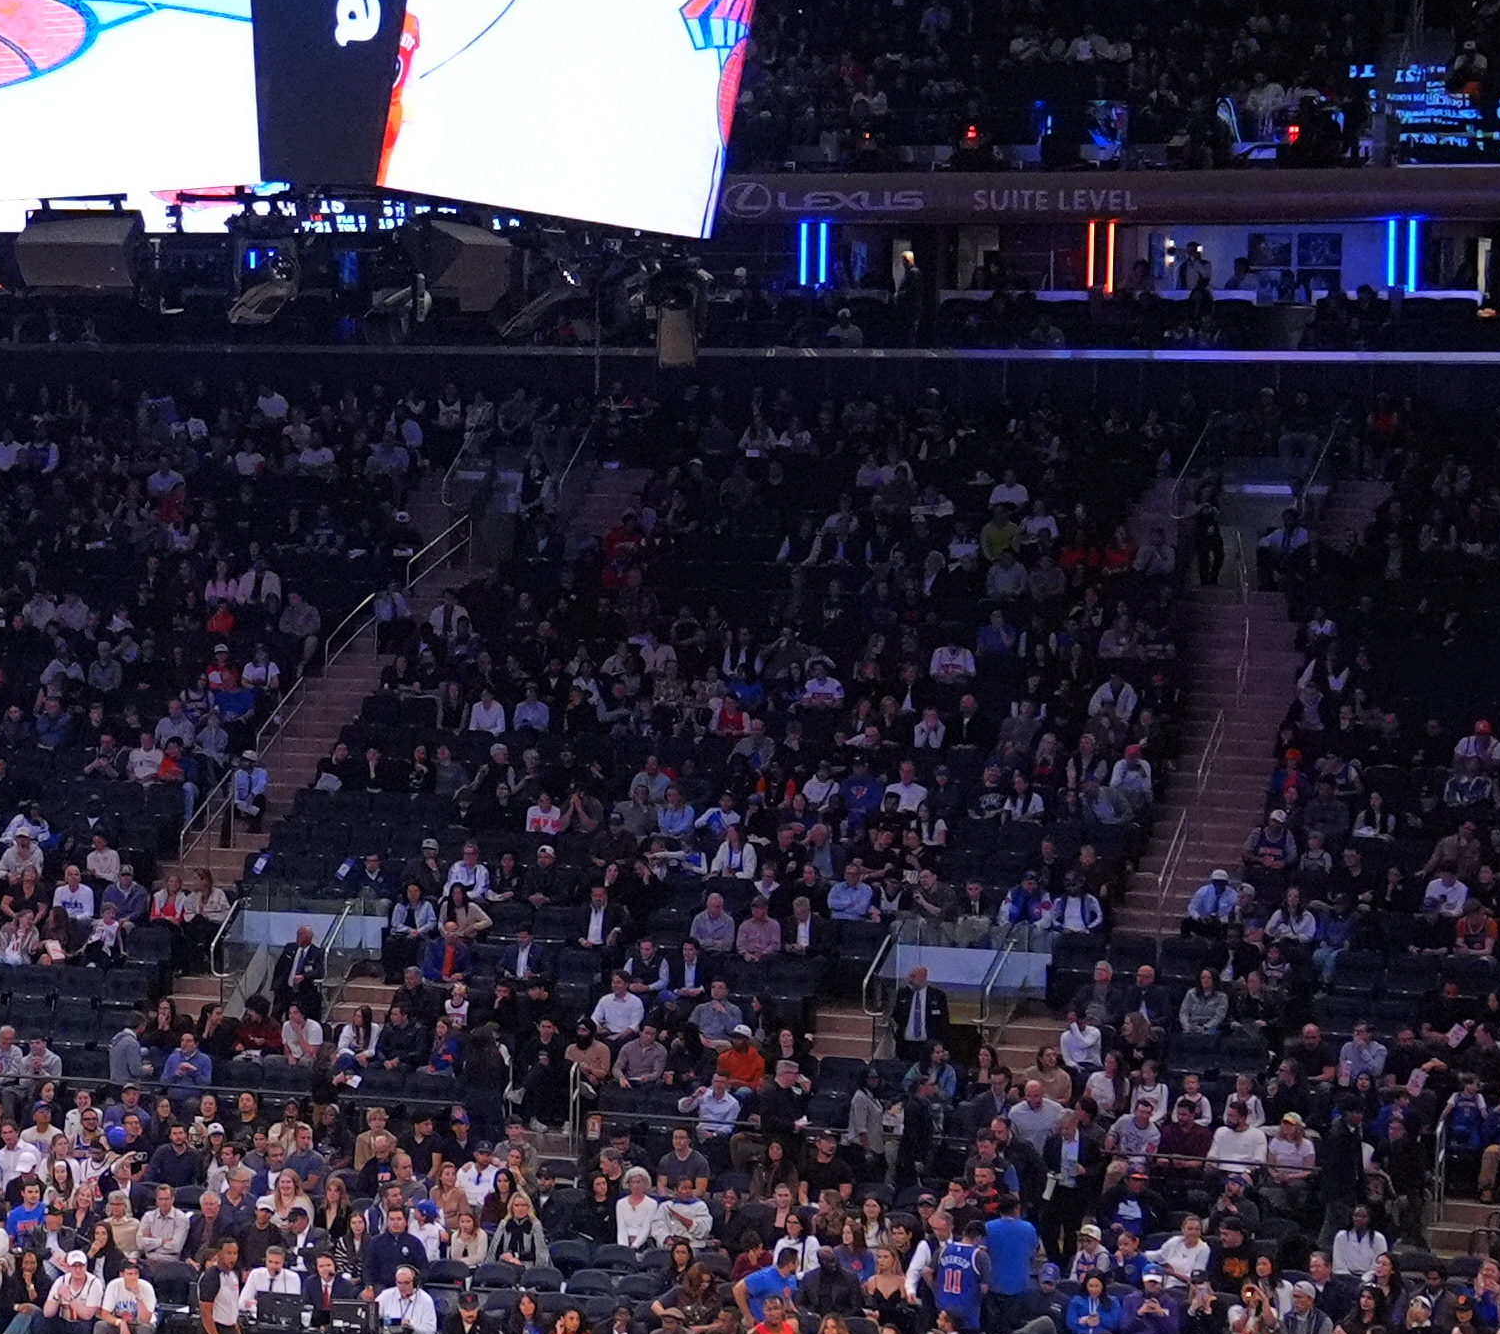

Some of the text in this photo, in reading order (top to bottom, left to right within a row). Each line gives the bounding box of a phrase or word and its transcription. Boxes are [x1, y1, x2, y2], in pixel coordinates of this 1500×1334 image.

[776, 189, 1138, 213] LEXUS SUITE LEVEL
